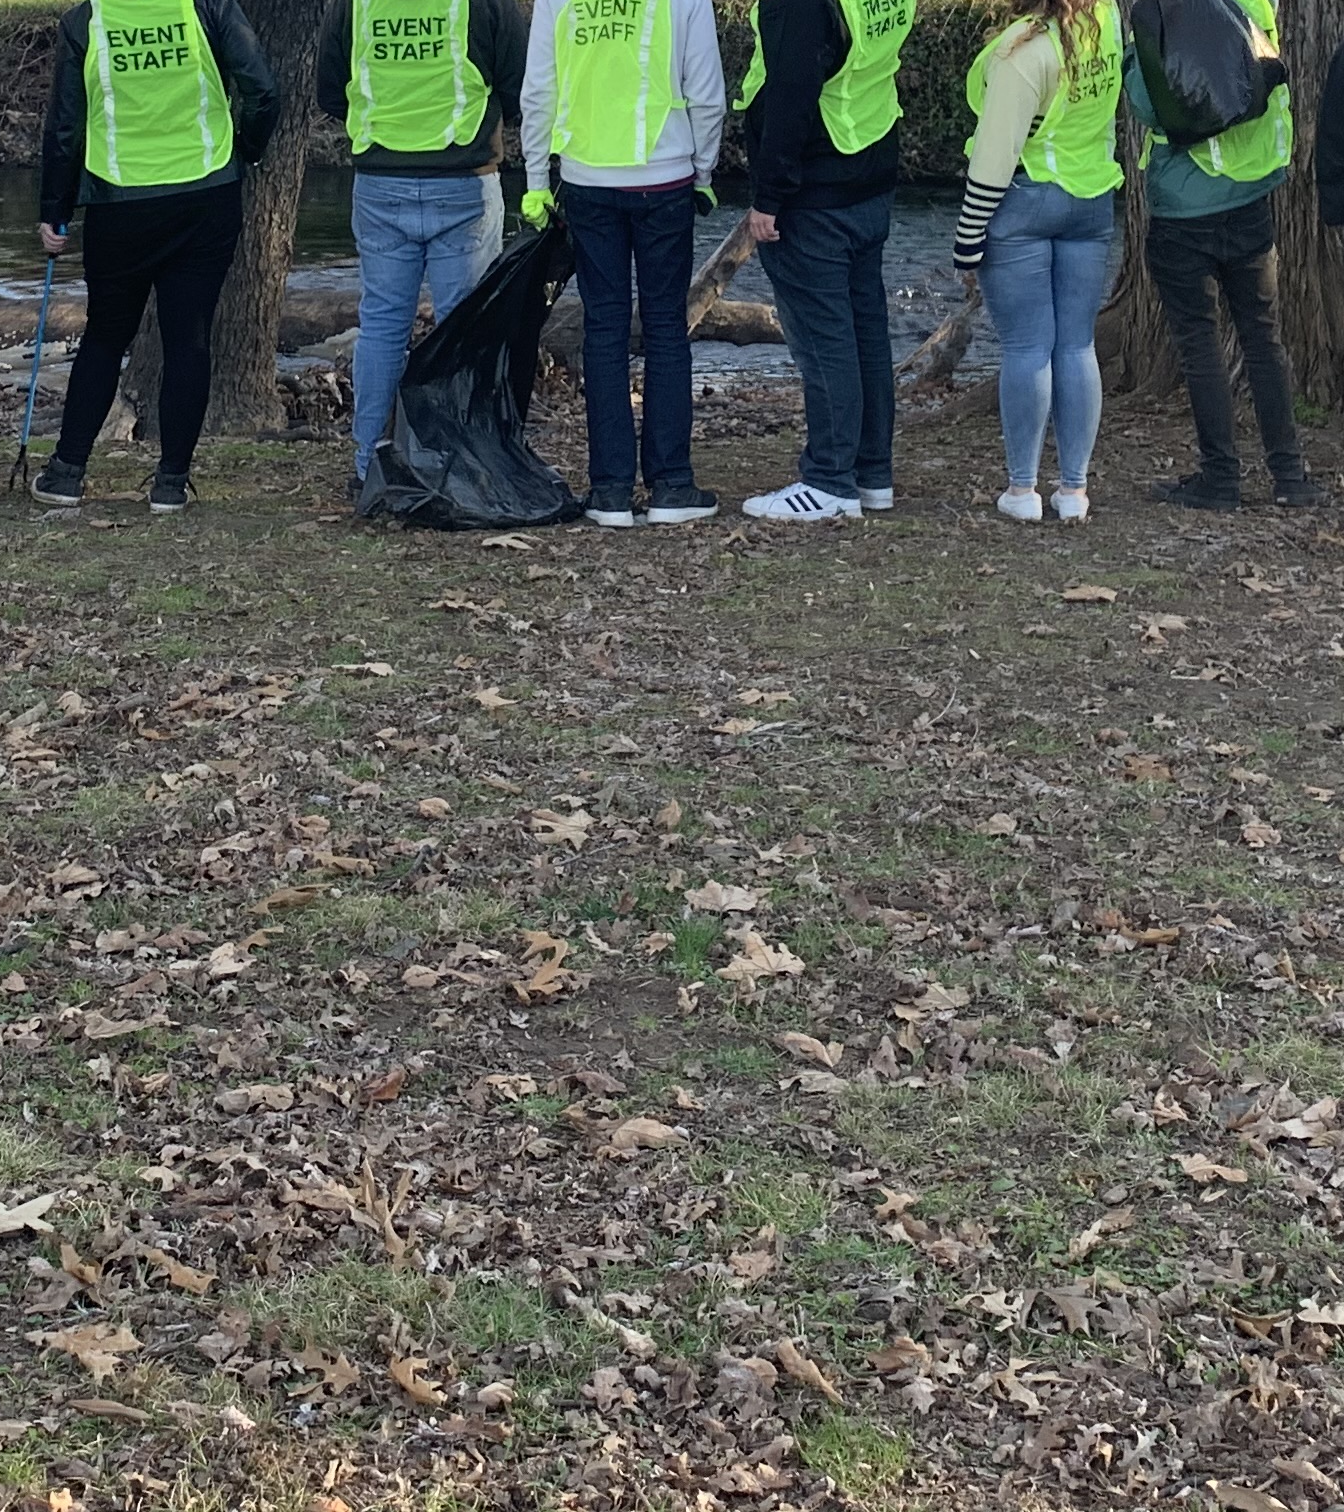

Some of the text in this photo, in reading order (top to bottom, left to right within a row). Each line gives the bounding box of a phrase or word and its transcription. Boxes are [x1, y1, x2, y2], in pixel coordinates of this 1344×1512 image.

[107, 22, 188, 48] EVENT
[372, 17, 447, 37] EVENT
[574, 21, 637, 46] STAFF
[112, 47, 189, 72] STAFF
[373, 40, 445, 61] STAFF
